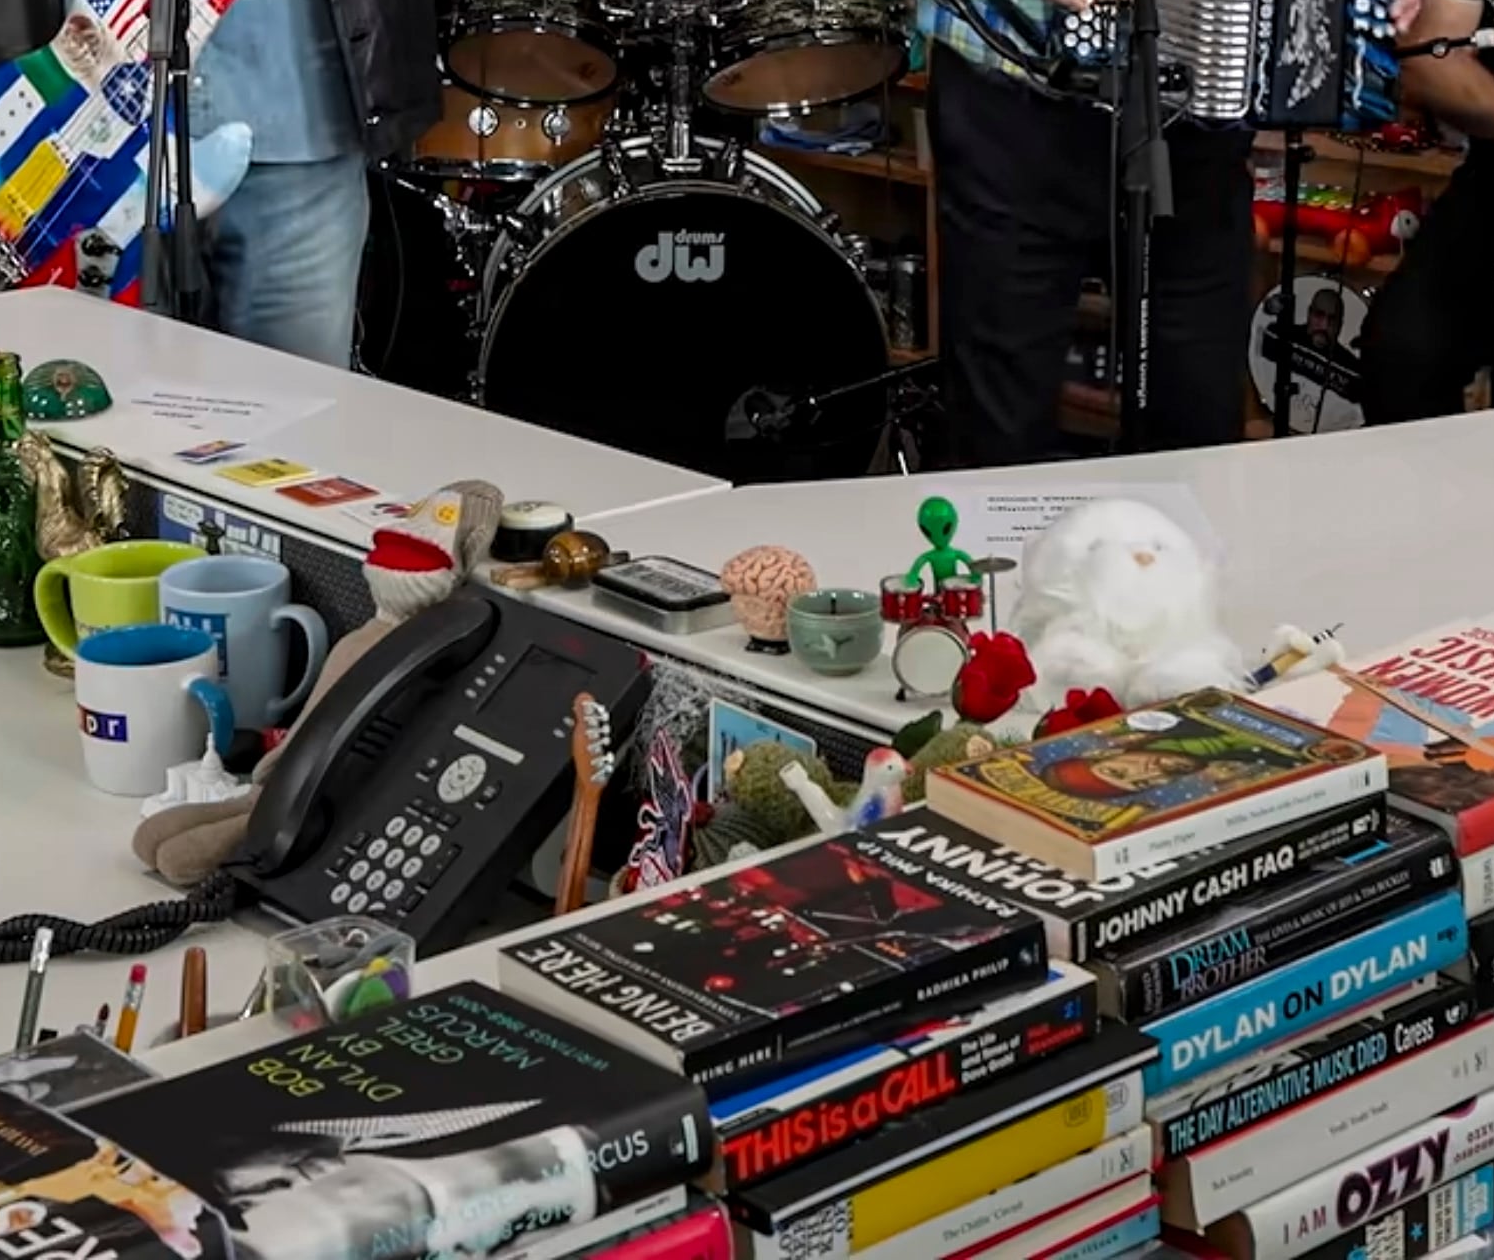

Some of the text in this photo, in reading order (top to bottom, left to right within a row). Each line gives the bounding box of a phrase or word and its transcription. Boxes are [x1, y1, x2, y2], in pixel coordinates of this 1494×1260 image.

[635, 231, 726, 283] dw
[674, 227, 726, 244] drums
[877, 824, 1103, 911] JOHNNY
[1095, 845, 1295, 947] JOHNNY CASH FAQ
[517, 939, 716, 1042] BEING HERE
[917, 960, 1009, 1002] RADHIKA PHILIP
[1170, 926, 1267, 1001] DREAM BROTHER
[379, 1014, 465, 1065] GREIL
[407, 1002, 544, 1072] MARCUS
[1171, 935, 1429, 1072] DYLAN ON DYLAN
[247, 1058, 325, 1098] BOB
[288, 1032, 405, 1104] DYLAN BY
[692, 1047, 772, 1084] BEING HERE
[1168, 1119, 1195, 1155] THE
[1197, 1110, 1225, 1143] DAY
[1225, 1067, 1312, 1134] ALTERNATIVE
[1314, 1050, 1356, 1092] MUSIC
[1357, 1031, 1388, 1073] DIED
[722, 1052, 955, 1181] THIS is a CALL
[1466, 1121, 1494, 1141] OZZY
[1283, 1128, 1451, 1244] I AM OZZY
